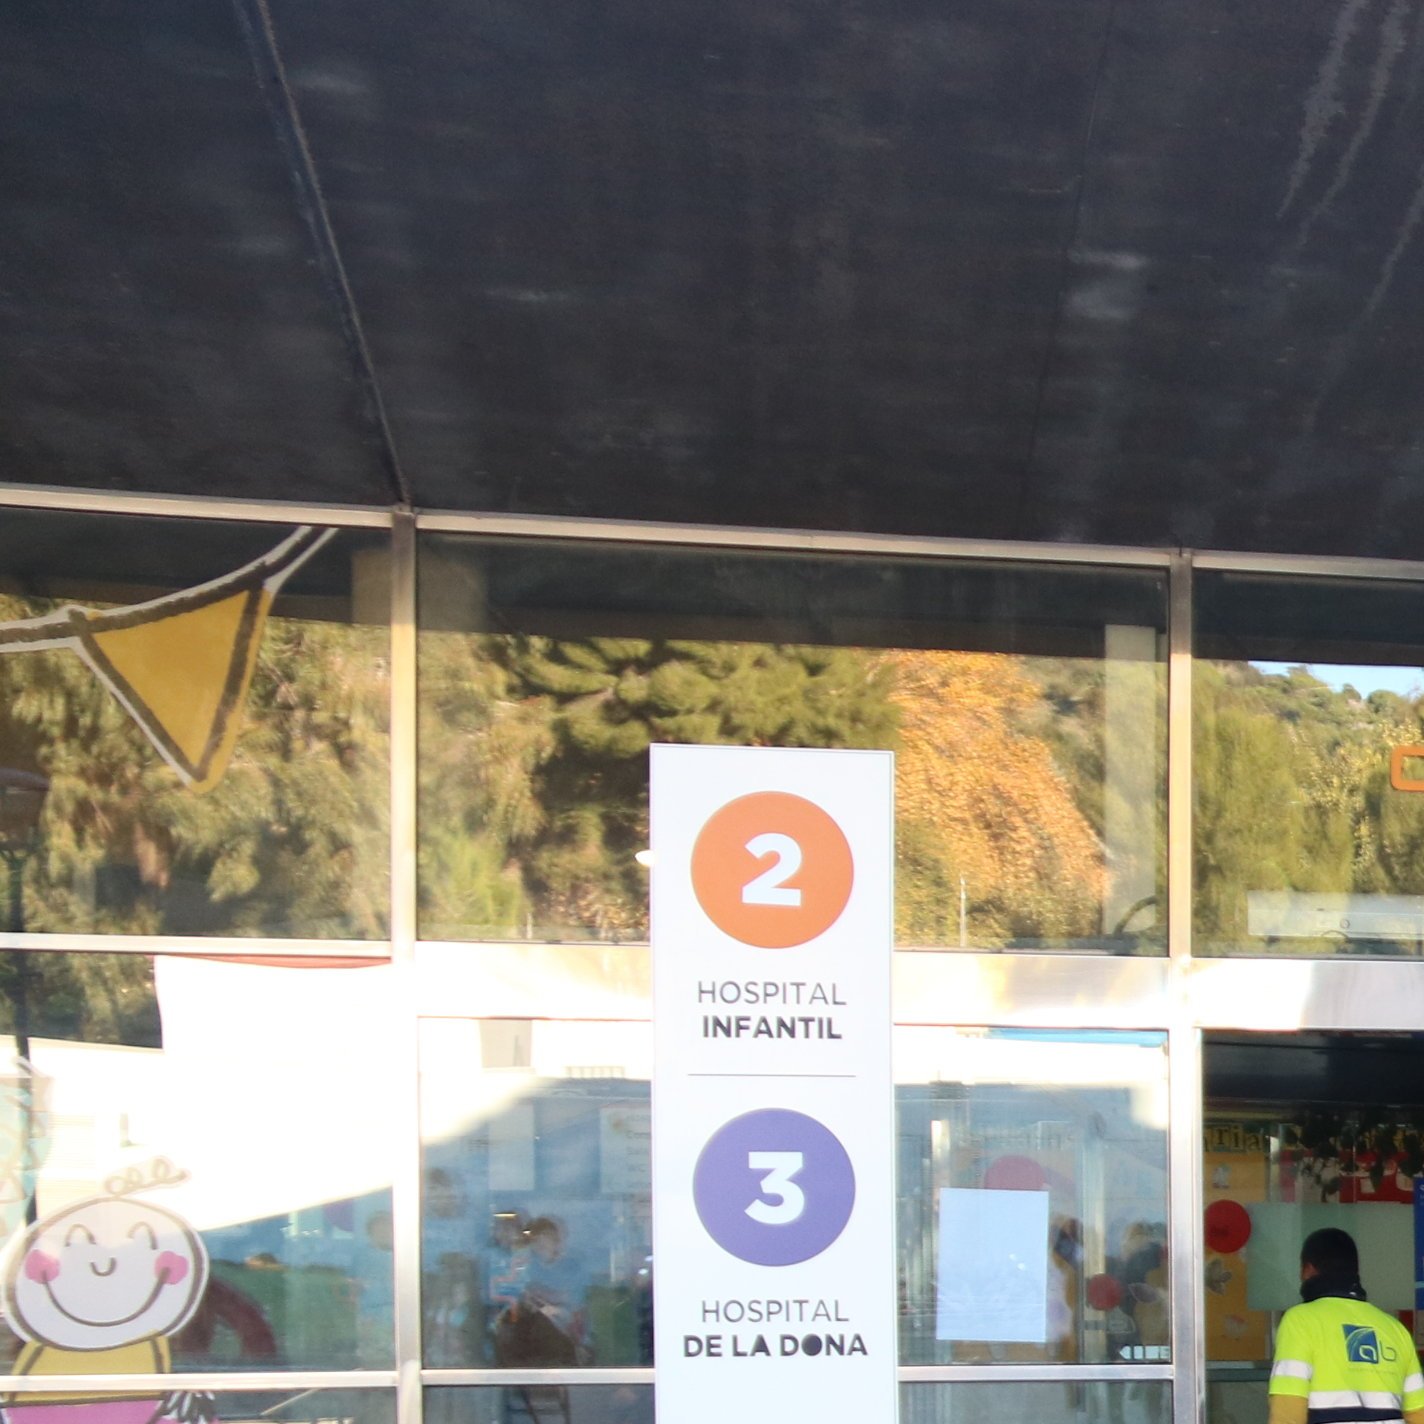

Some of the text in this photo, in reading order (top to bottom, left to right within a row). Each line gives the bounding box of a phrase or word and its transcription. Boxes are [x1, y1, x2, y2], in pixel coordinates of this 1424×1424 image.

[742, 832, 803, 907] 2
[697, 981, 847, 1006] HOSPITAL
[702, 1015, 843, 1041] INFANTIL
[743, 1150, 806, 1225] 3
[701, 1299, 850, 1323] HOSPITAL
[682, 1332, 869, 1358] DE LA DONA
